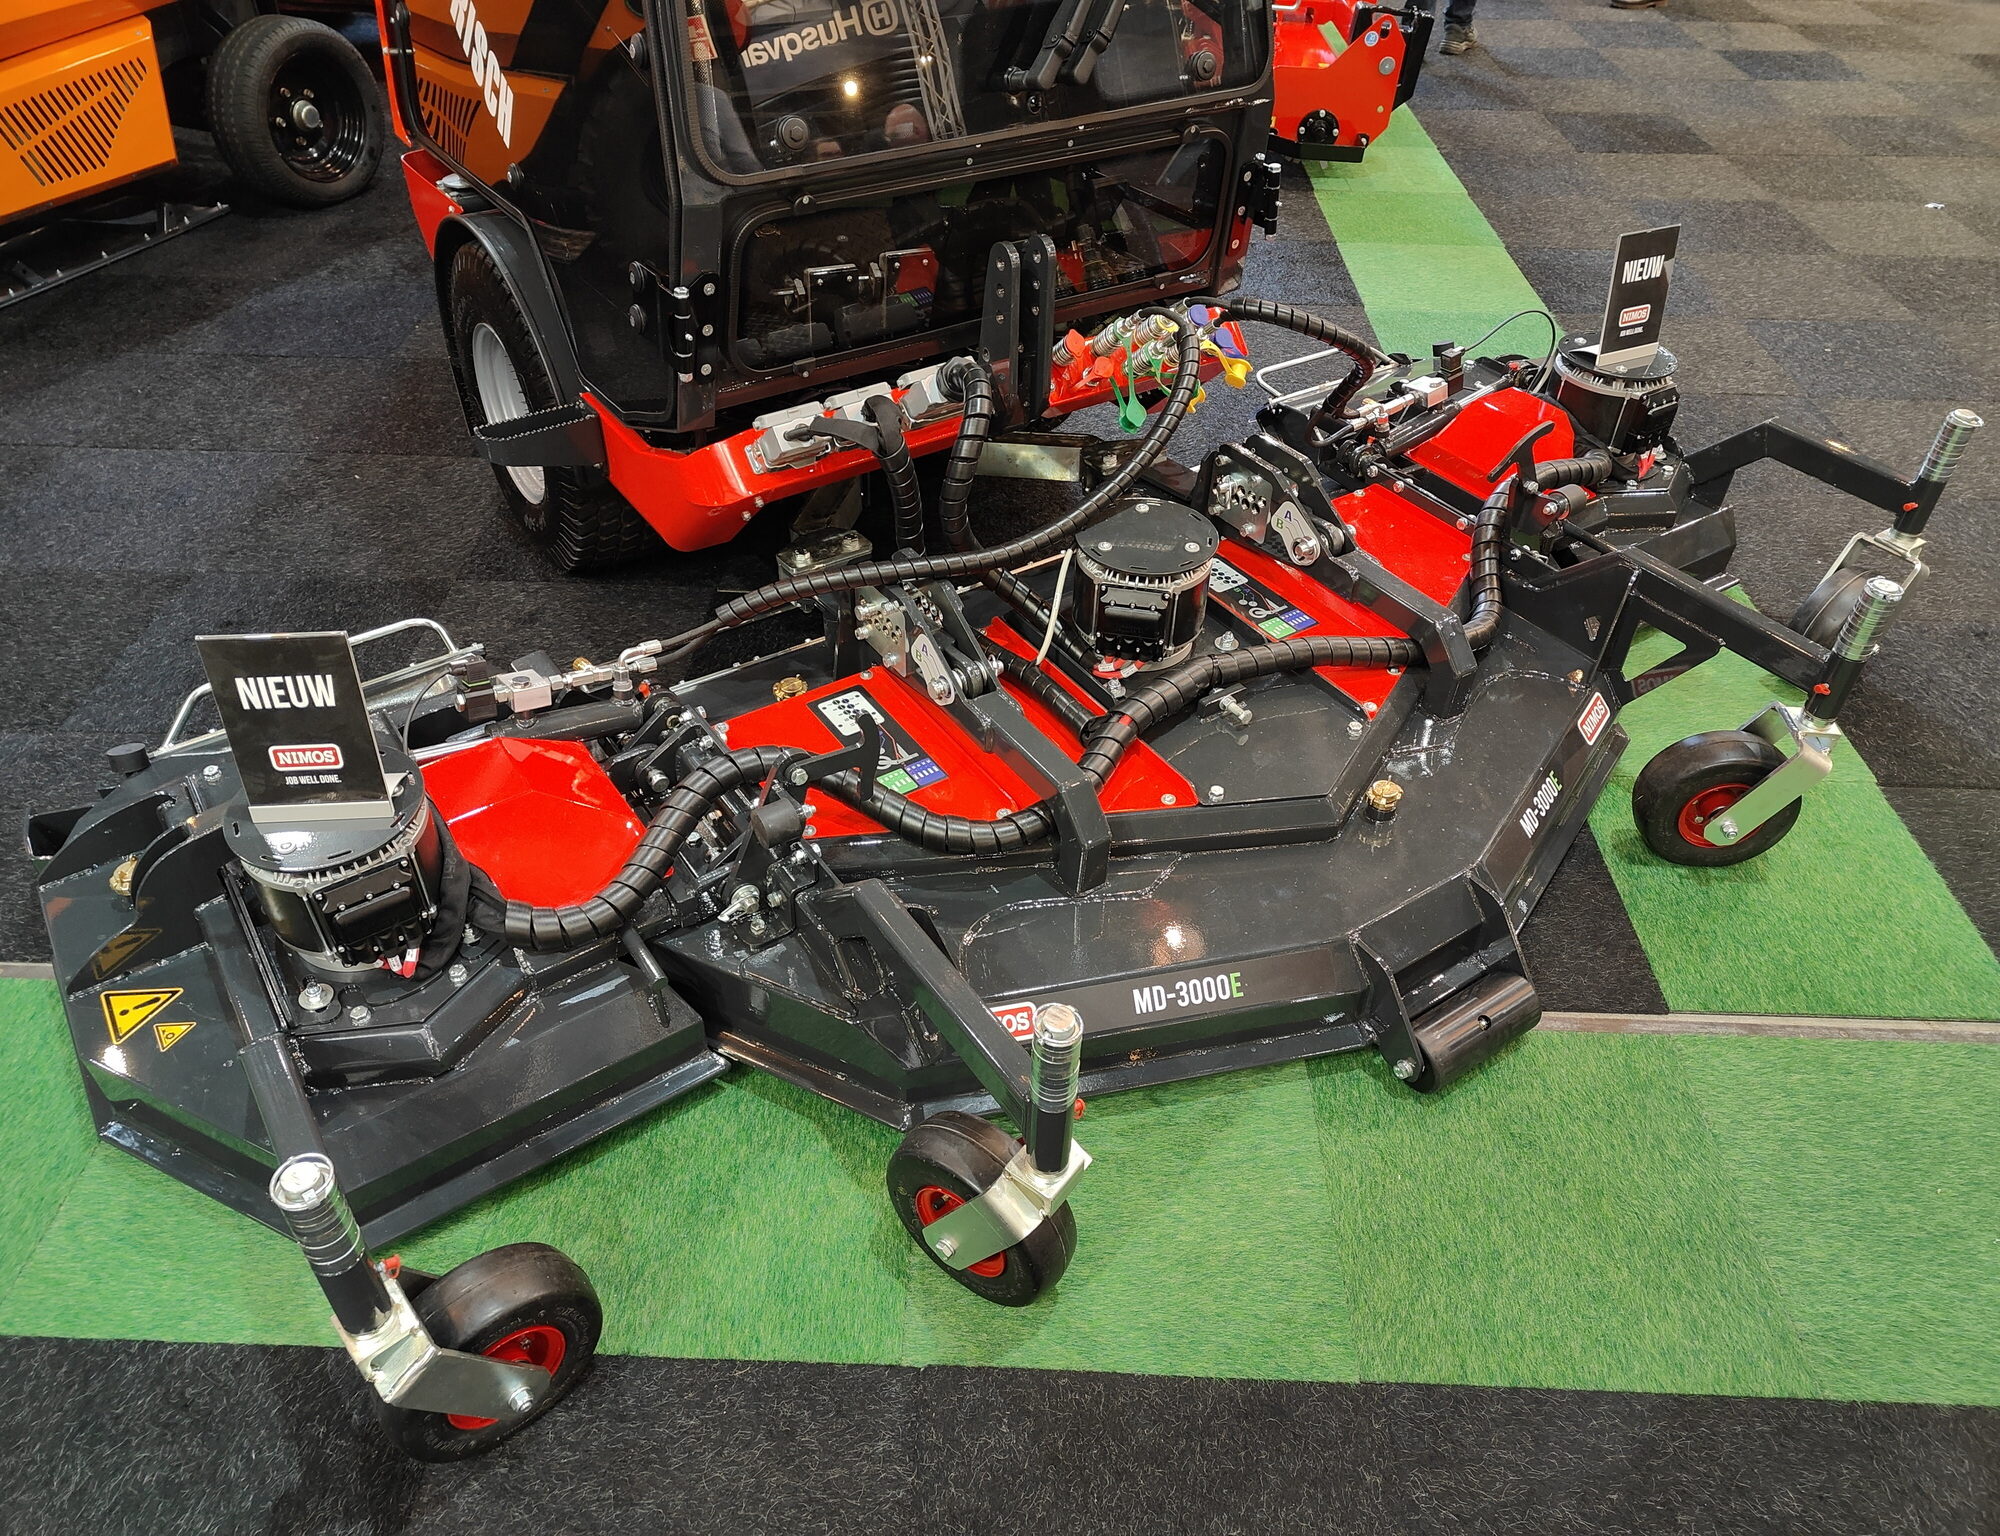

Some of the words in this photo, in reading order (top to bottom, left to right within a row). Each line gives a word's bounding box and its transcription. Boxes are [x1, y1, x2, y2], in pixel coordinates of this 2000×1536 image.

[1622, 255, 1665, 284] NIEUW
[235, 674, 336, 711] NIEUW
[1582, 701, 1607, 738] NIMOS
[277, 750, 336, 765] NIMOS
[285, 776, 299, 785] JOB
[299, 775, 320, 785] WELL
[1519, 770, 1563, 839] MD-3000E
[1132, 971, 1244, 1015] MD-3000E
